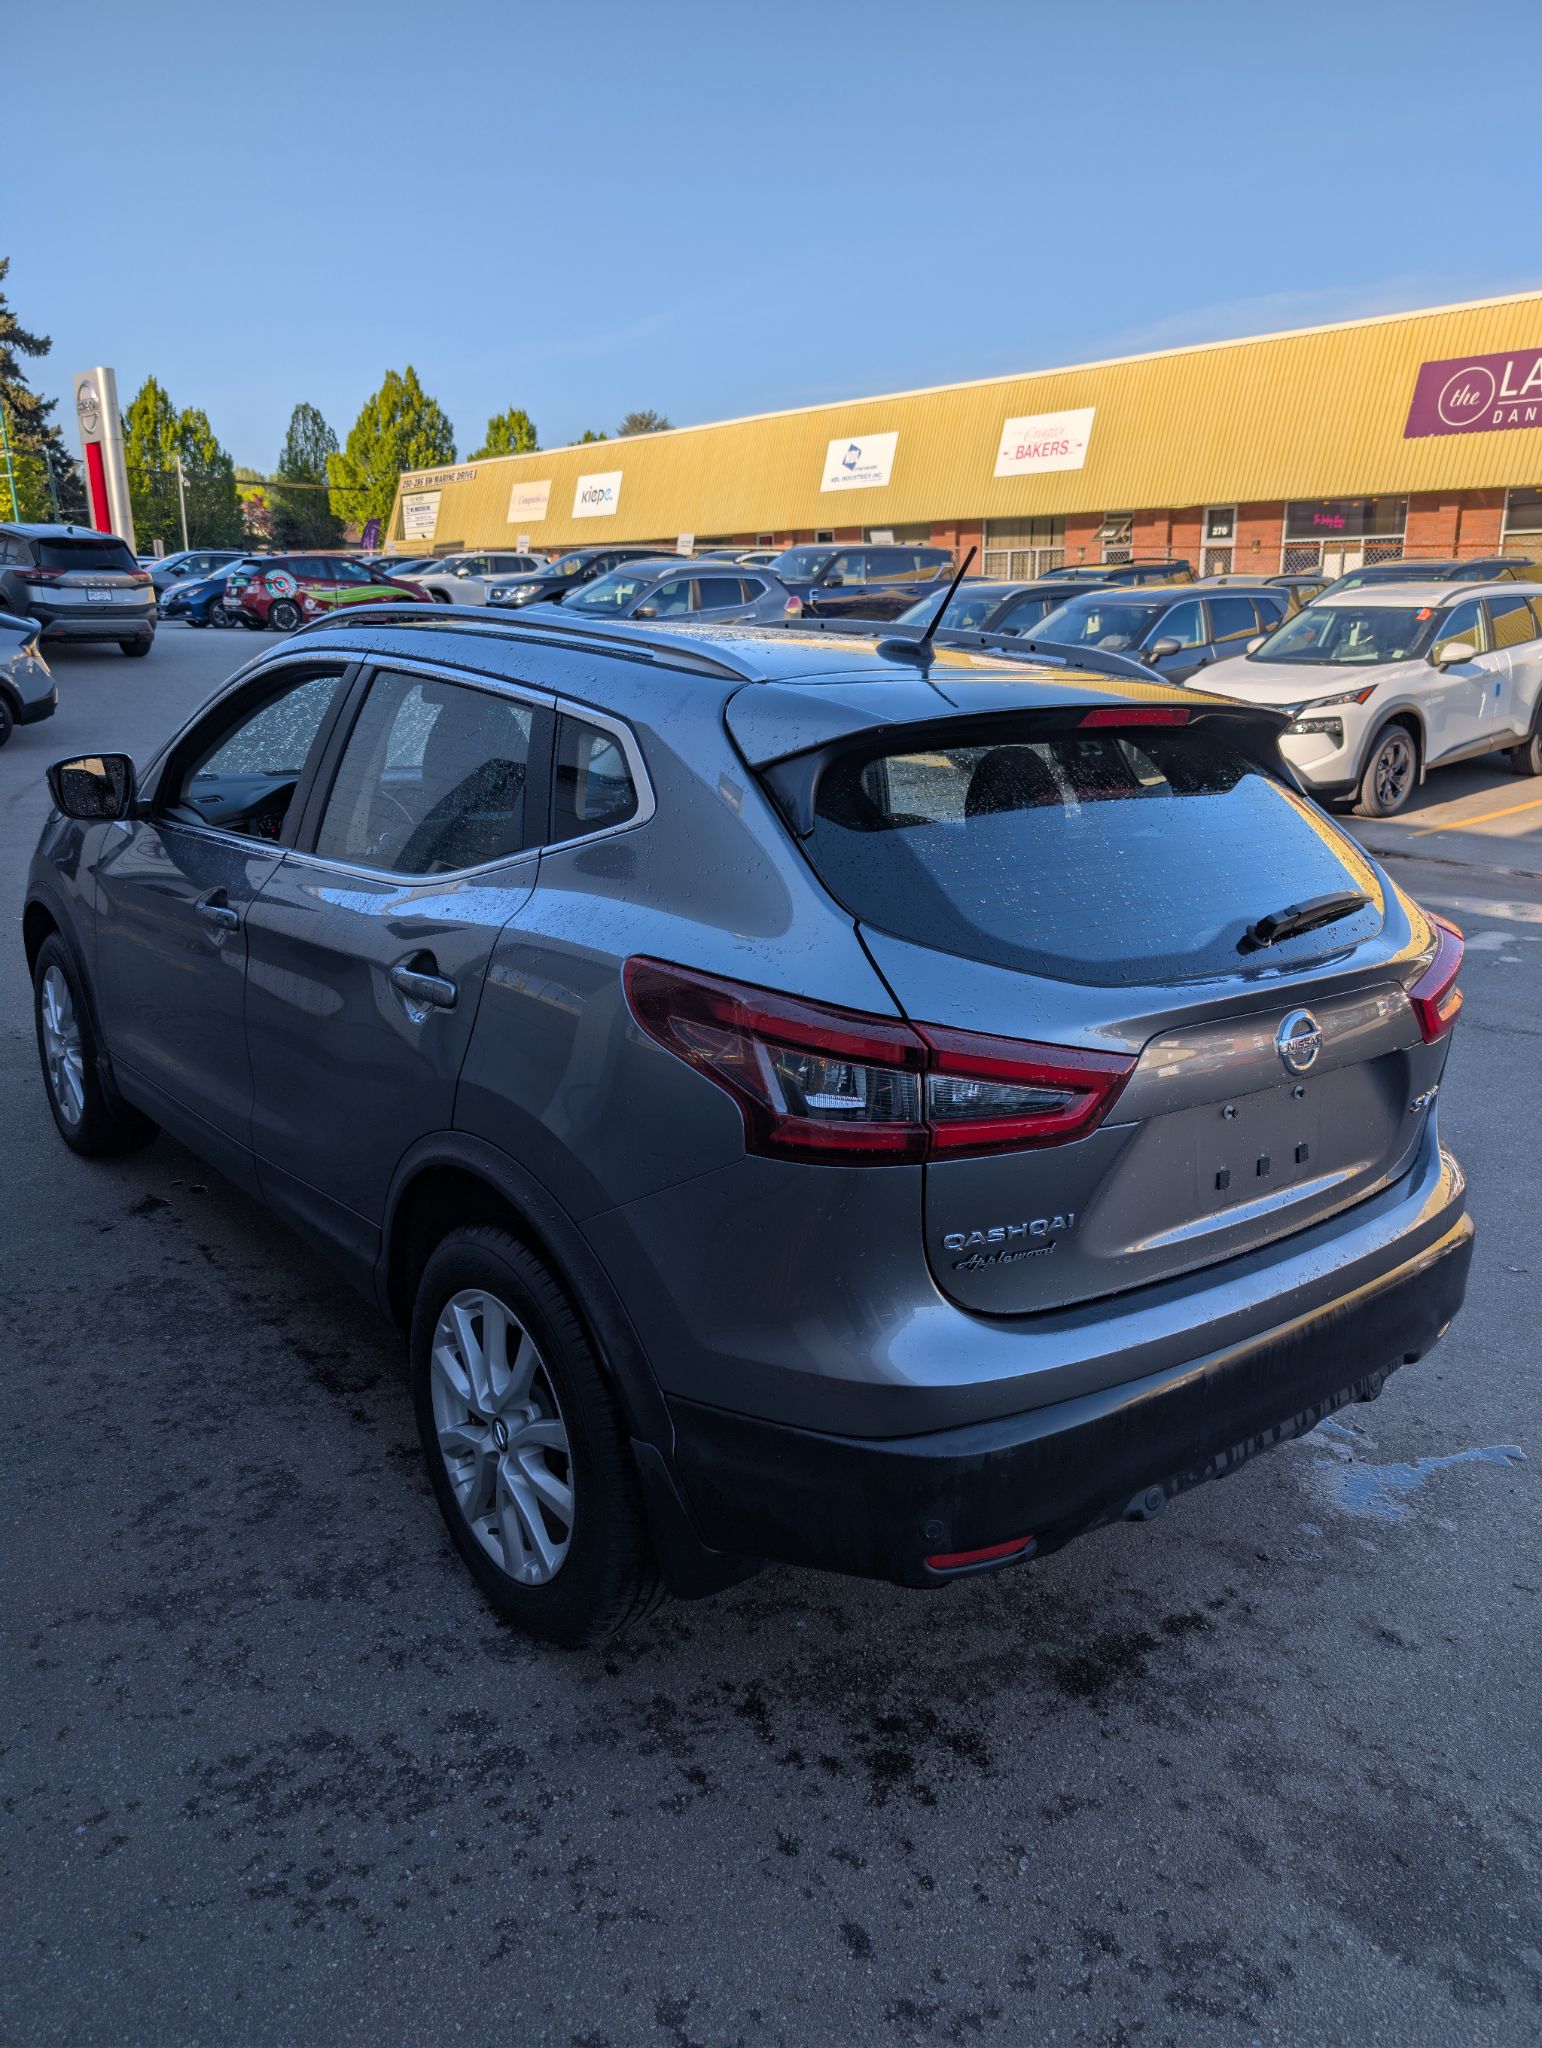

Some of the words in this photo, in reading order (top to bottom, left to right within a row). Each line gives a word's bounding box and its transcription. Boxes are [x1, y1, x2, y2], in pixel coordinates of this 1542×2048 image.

[1449, 383, 1480, 408] the
[1492, 407, 1537, 424] DAN
[1015, 439, 1070, 460] BAKERS
[456, 469, 474, 481] DRIVE
[943, 1213, 1075, 1251] QASHQAI
[955, 1241, 1057, 1272] Applewood
